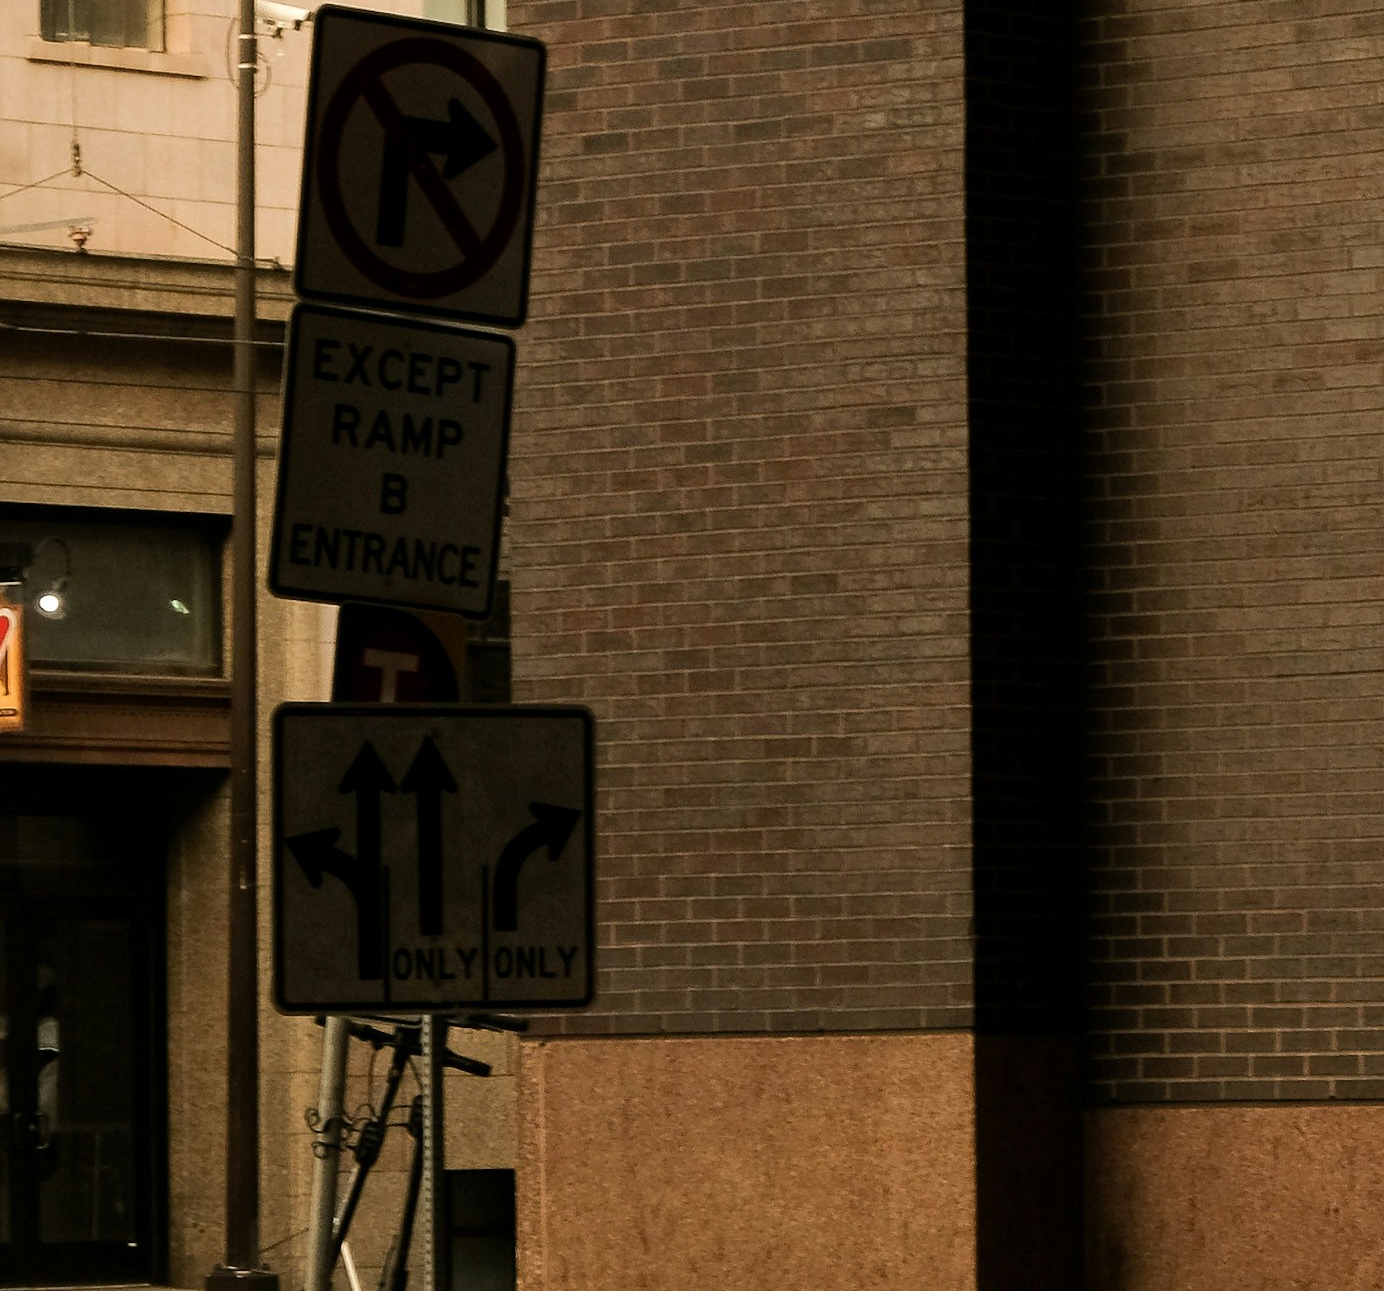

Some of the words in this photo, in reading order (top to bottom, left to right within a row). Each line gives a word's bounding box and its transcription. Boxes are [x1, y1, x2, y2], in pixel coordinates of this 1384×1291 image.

[314, 338, 490, 403] EXCEPT
[332, 403, 463, 459] RAMP
[380, 472, 407, 515] B
[290, 523, 481, 588] ENTRANCE
[393, 947, 478, 980] ONLY
[495, 946, 578, 979] ONLY
